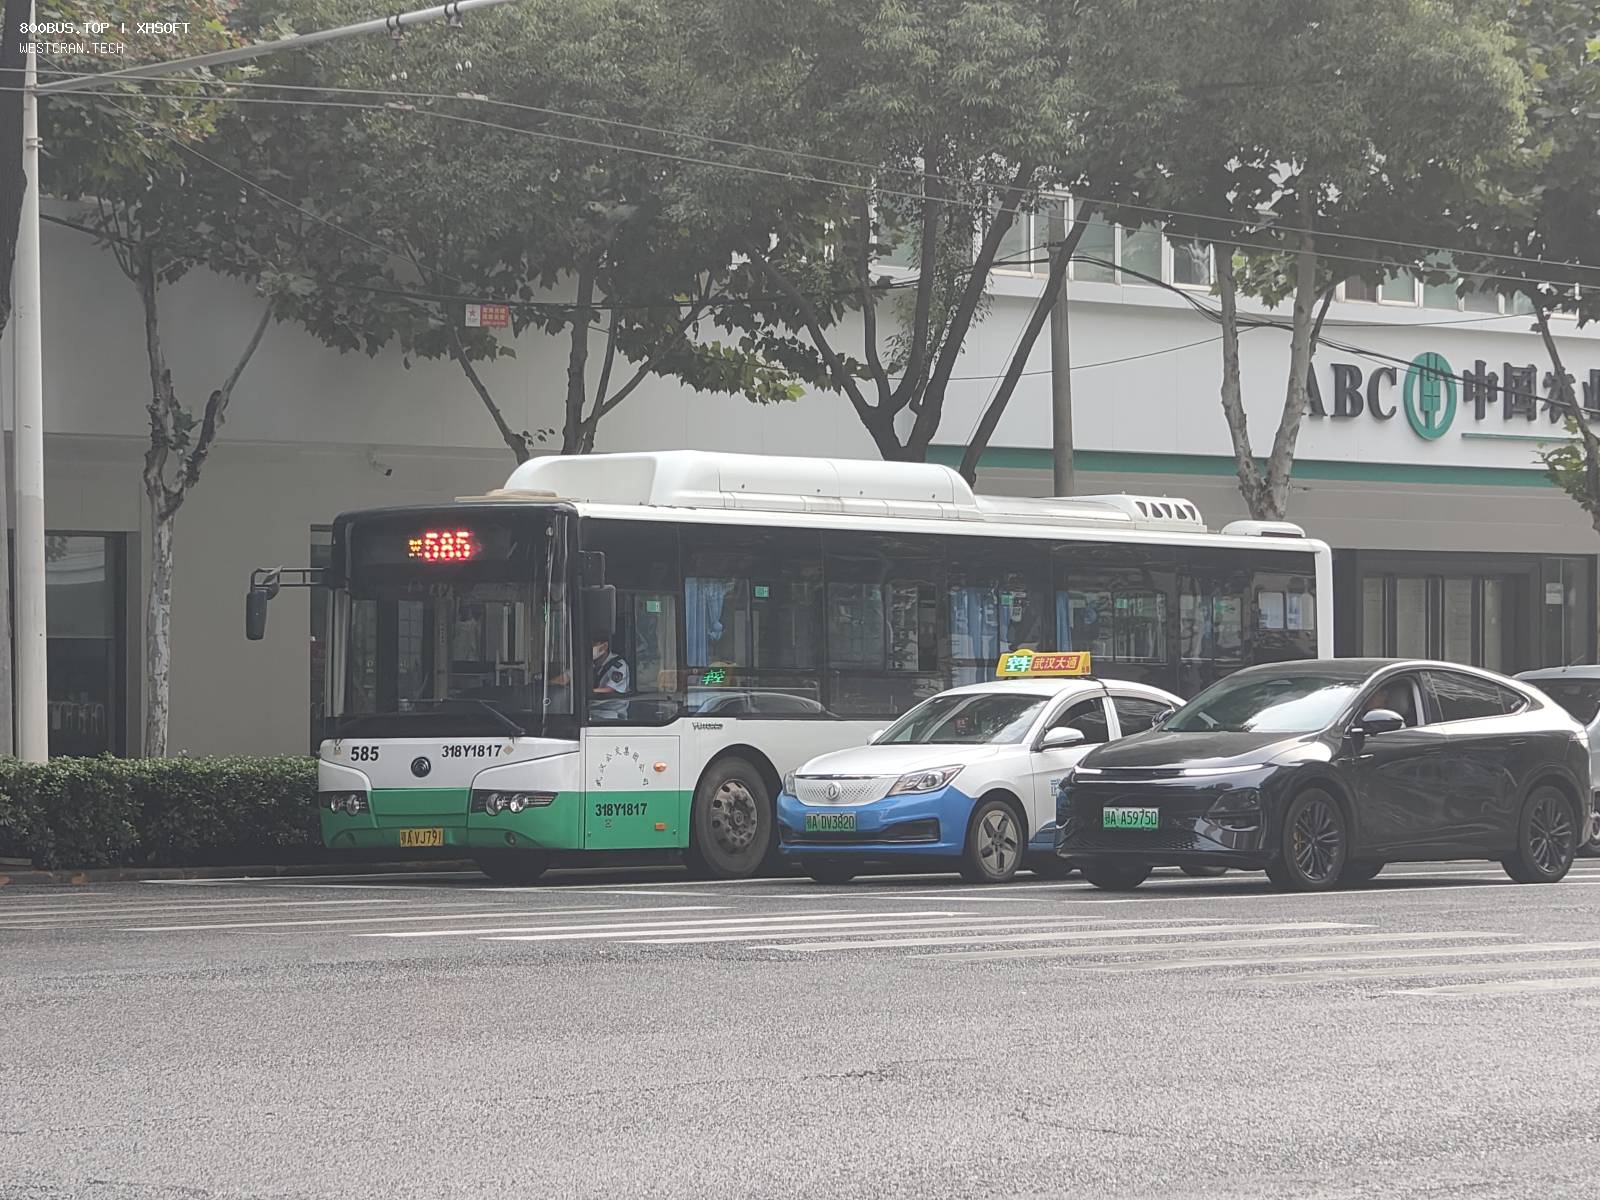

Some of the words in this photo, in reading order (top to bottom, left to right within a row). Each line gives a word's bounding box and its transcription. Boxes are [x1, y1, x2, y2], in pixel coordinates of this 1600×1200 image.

[1300, 363, 1397, 419] ABC
[424, 530, 471, 561] 585
[1005, 655, 1032, 673] 空车
[1033, 656, 1078, 670] 武汉大通
[350, 745, 379, 762] 585
[441, 744, 502, 758] 318Y1817
[595, 802, 648, 817] 318Y1817
